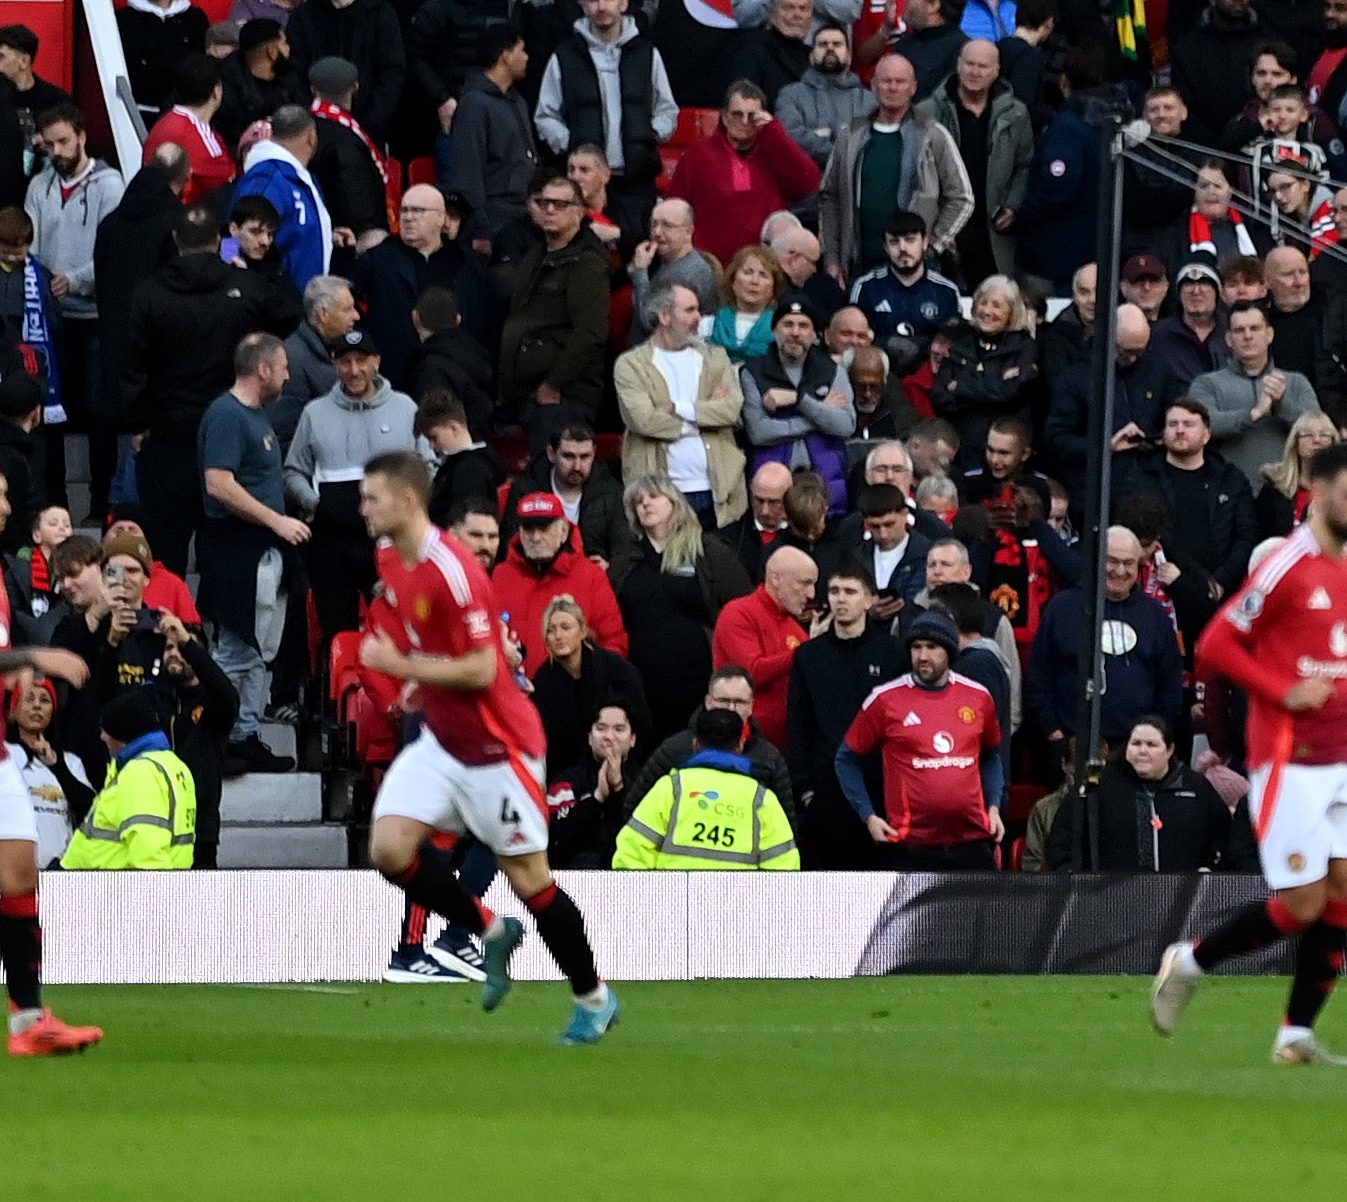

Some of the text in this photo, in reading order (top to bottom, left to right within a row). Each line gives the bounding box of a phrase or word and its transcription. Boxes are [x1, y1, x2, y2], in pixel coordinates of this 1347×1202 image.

[910, 755, 975, 770] Snapdragon
[500, 796, 523, 825] 4
[713, 800, 746, 820] CSG
[691, 821, 735, 849] 245
